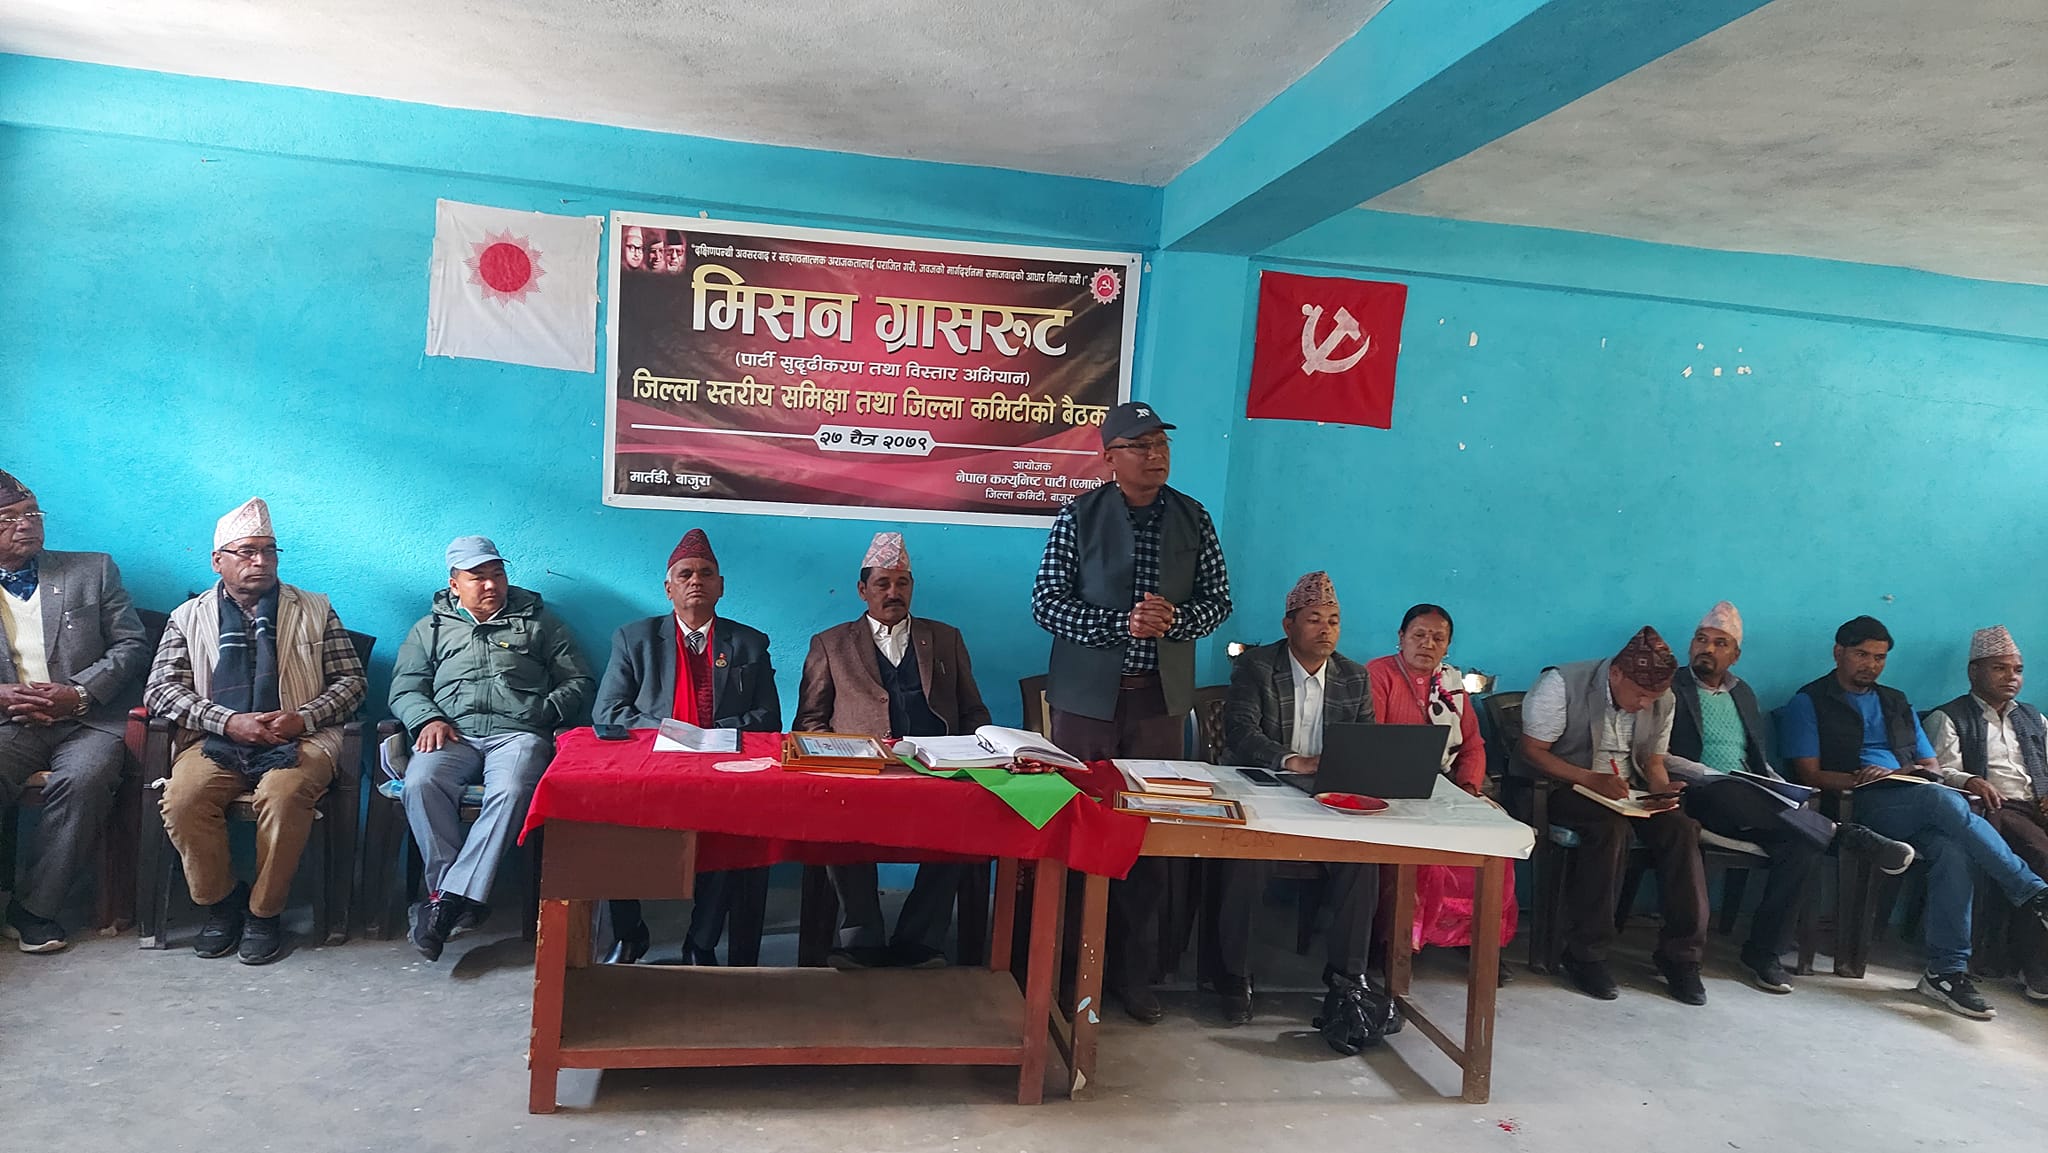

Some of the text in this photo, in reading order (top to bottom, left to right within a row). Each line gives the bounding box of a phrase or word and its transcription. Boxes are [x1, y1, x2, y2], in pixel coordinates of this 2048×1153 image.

[772, 252, 777, 261] र
[828, 256, 875, 270] अराजकतालाई
[876, 258, 901, 271] पराजित
[947, 264, 984, 278] मार्गदर्शनमा
[985, 268, 1024, 281] समाजवादको
[1025, 272, 1045, 283] आधार
[1047, 270, 1067, 284] निर्माण
[692, 264, 859, 342] मिसन
[736, 351, 1030, 387] (पार्टी सुदृढीकरण तथा विस्तार अभियान)
[632, 367, 1110, 426] जिल्ला स्तरीय समिक्षा तथा जिल्ला कमिटीको बैठक
[820, 429, 927, 450] २७ चैत्र २०७९
[1012, 460, 1052, 471] आयोजक
[675, 473, 712, 490] बाजुरा
[955, 470, 987, 484] नेपाल
[990, 472, 1041, 488] कम्युनिष्ट
[1045, 476, 1067, 488] पार्टी
[985, 487, 1013, 500] जिल्ला
[1016, 489, 1047, 502] कमिटी,
